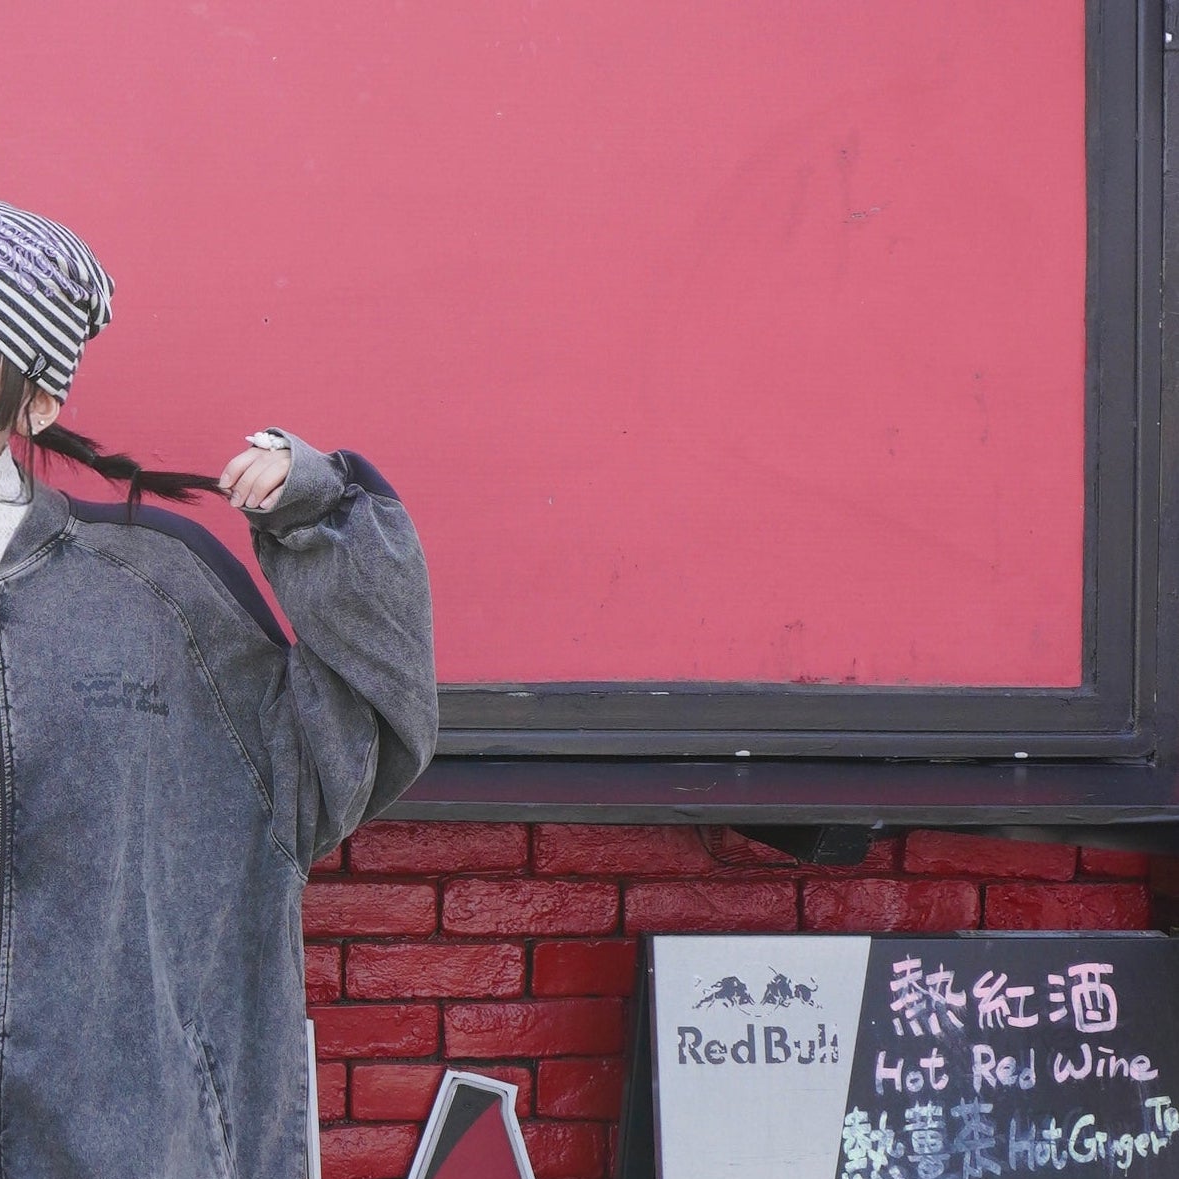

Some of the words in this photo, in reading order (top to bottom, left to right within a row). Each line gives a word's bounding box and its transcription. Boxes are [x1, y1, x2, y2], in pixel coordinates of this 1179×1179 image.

[889, 953, 1119, 1036] 熱紅酒
[677, 1023, 756, 1064] Red
[875, 1048, 949, 1096] Hot
[972, 1044, 1036, 1093] Red
[1008, 1115, 1068, 1172] Hot
